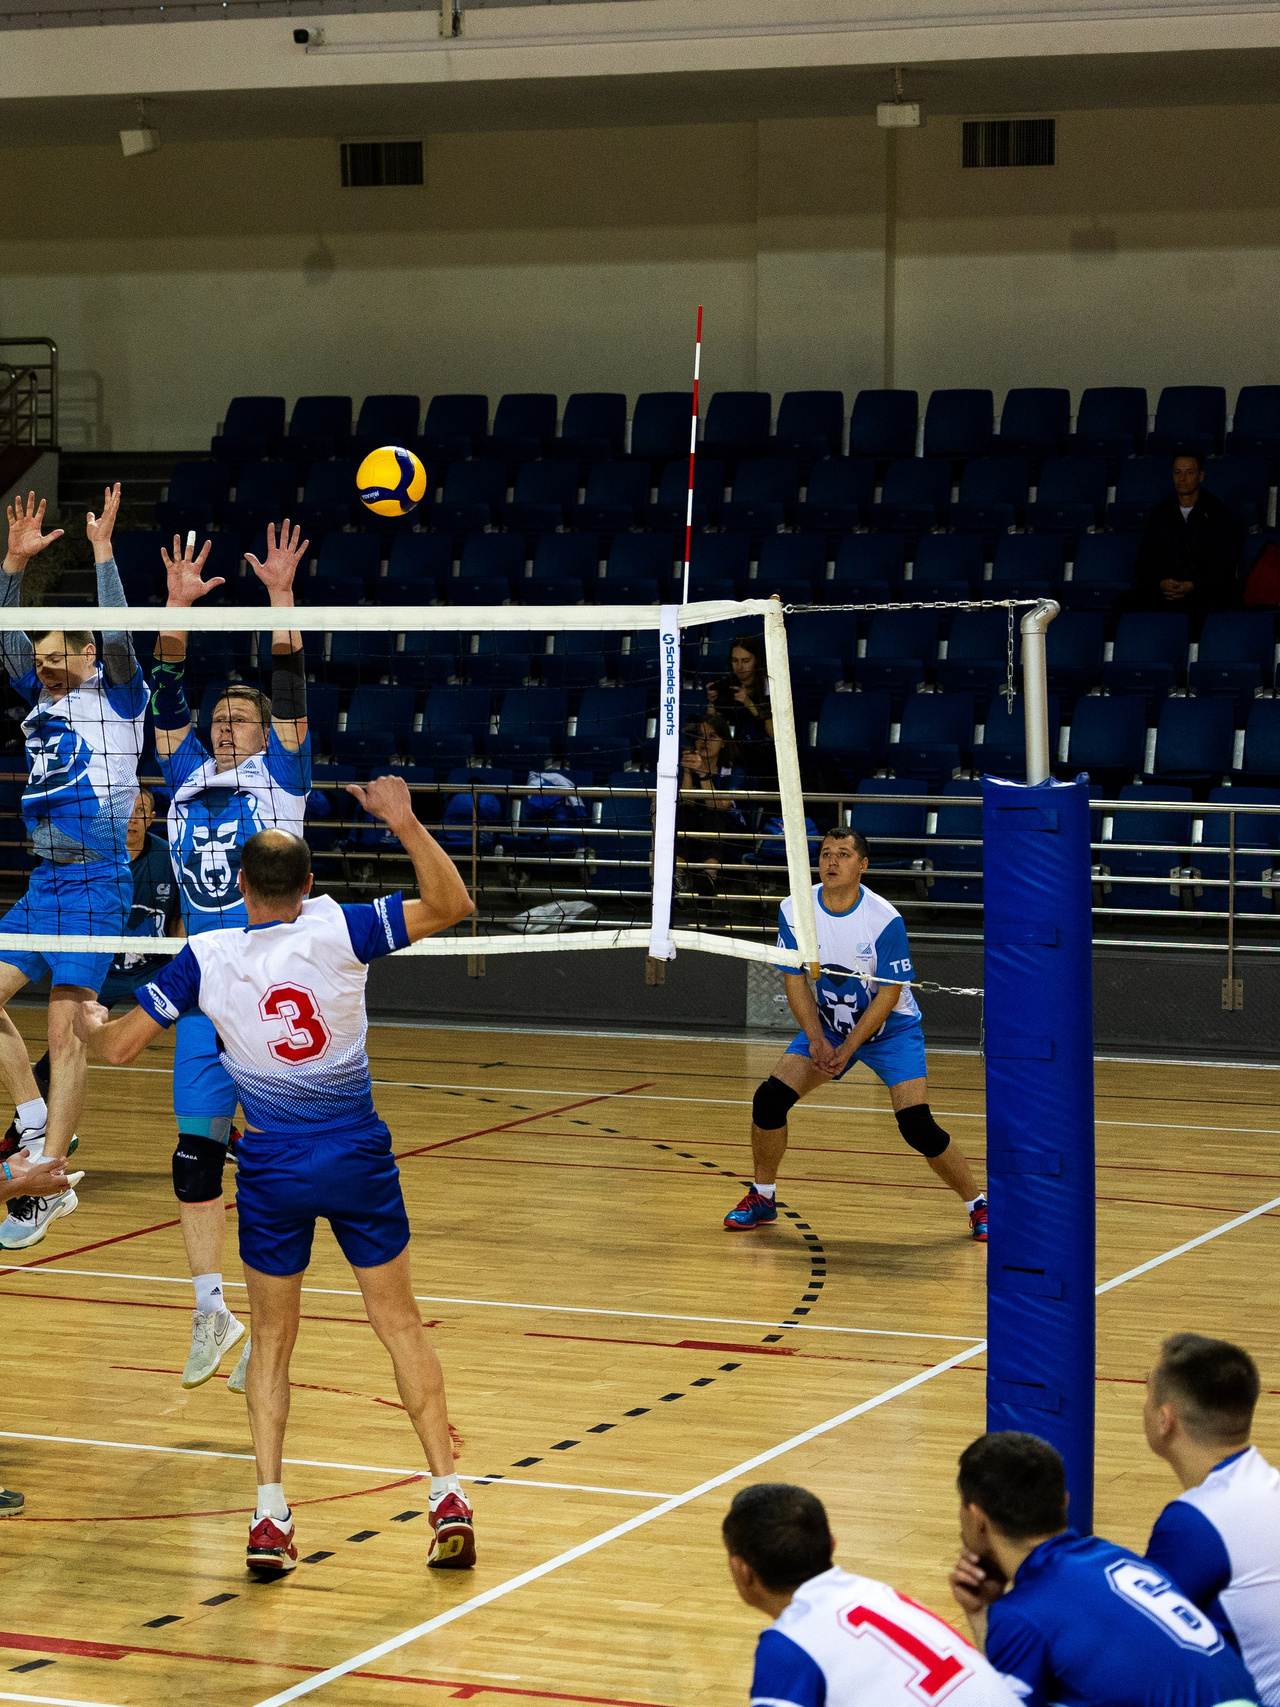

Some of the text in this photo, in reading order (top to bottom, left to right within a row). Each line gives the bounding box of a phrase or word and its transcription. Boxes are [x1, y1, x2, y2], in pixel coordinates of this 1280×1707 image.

[663, 646, 676, 736] Schelde Sports
[258, 981, 332, 1066] 3
[1104, 1558, 1226, 1657] 6
